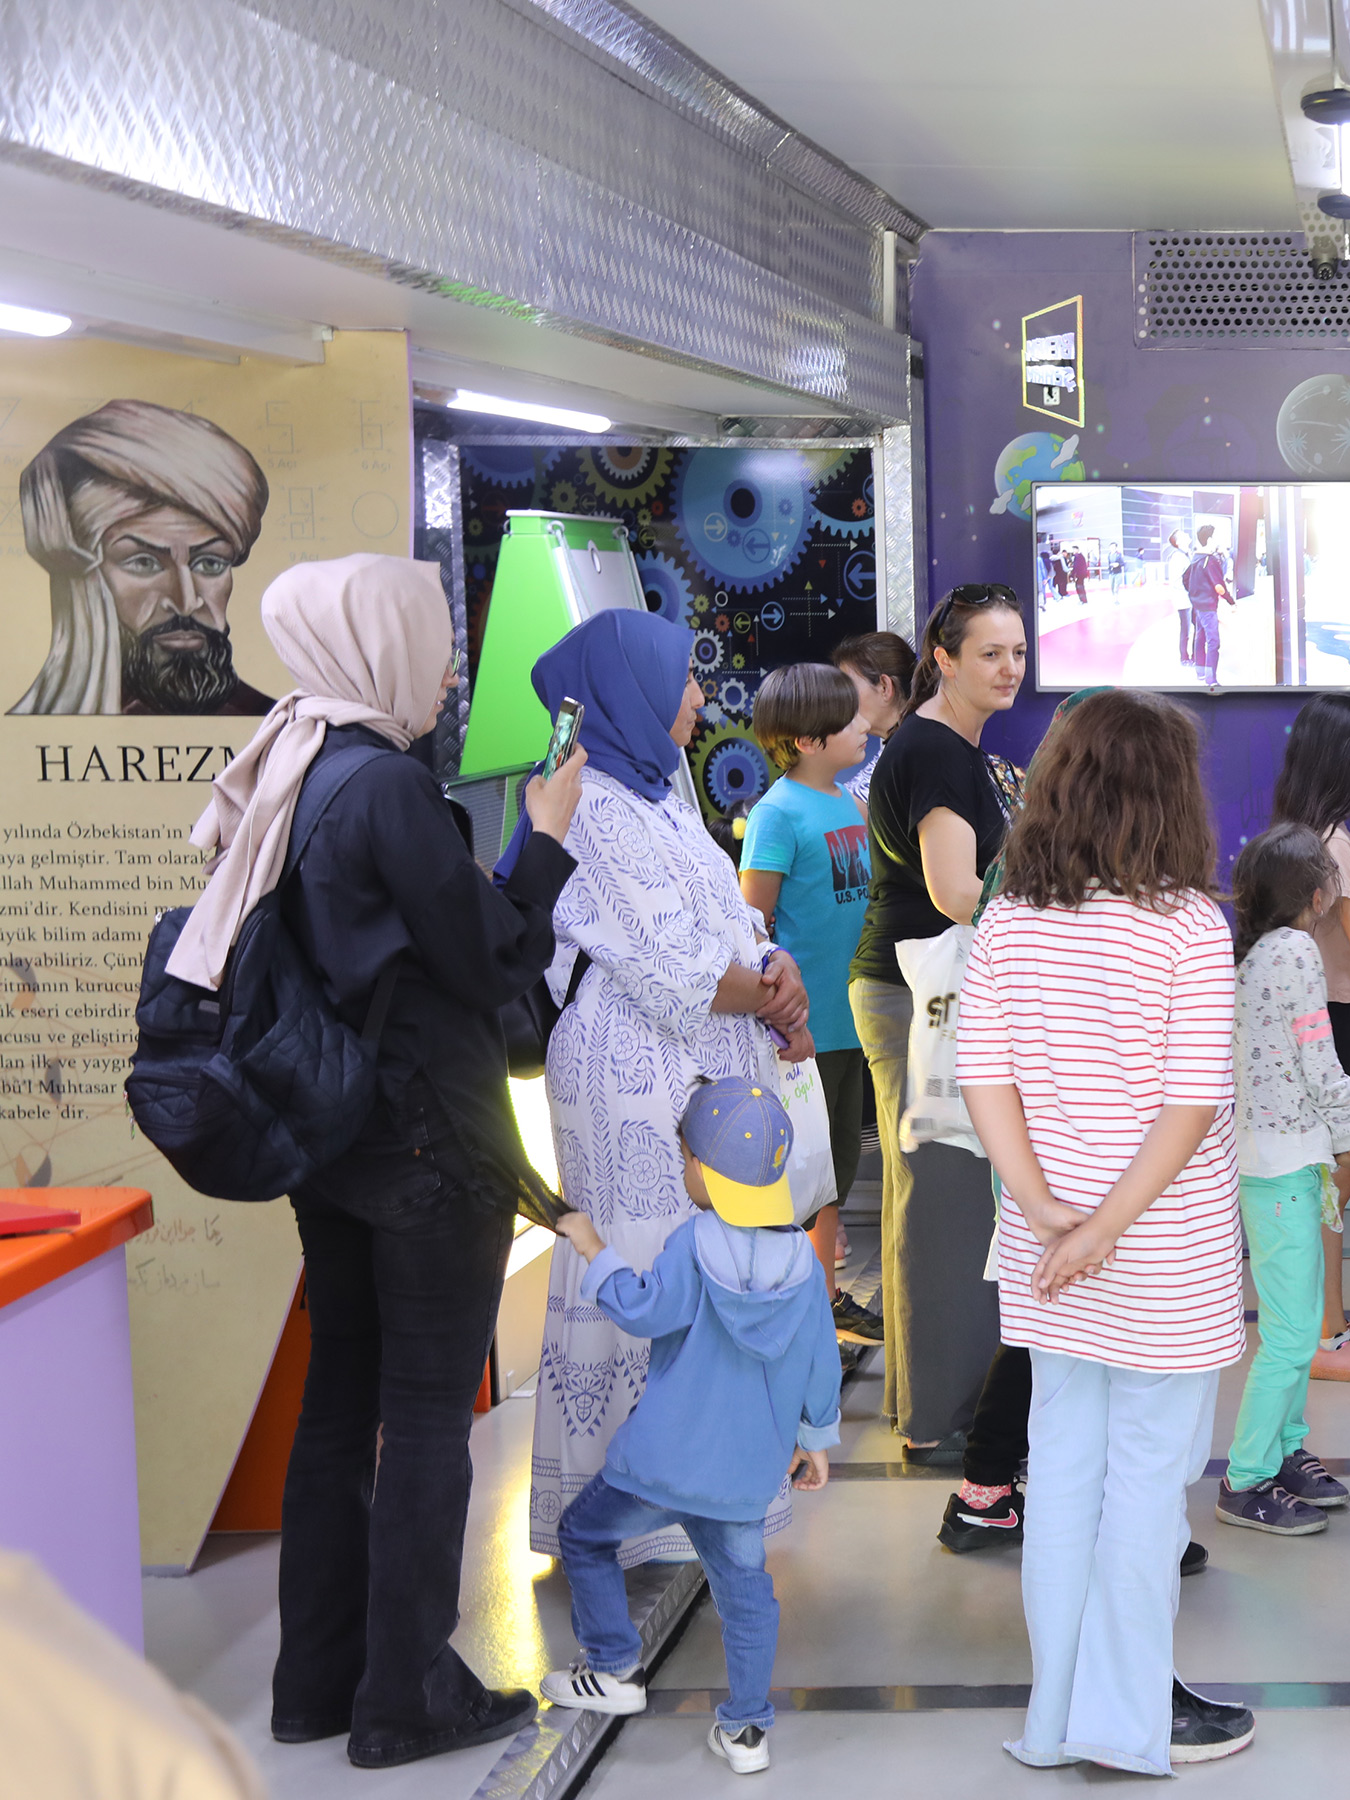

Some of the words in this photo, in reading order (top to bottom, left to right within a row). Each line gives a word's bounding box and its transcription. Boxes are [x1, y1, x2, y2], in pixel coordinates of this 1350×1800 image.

[3, 823, 62, 843] yılında
[30, 849, 110, 869] gelmiştir.
[114, 849, 152, 865] Tam
[157, 849, 209, 865] olarak
[39, 874, 141, 891] Muhammed
[146, 874, 173, 891] bin
[179, 875, 207, 891] Mu
[835, 890, 856, 904] U.S.
[69, 900, 148, 917] Kendisini
[42, 926, 87, 942] bilim
[91, 926, 142, 942] adamı
[20, 1003, 60, 1019] eseri
[64, 1002, 136, 1019] cebirdir.
[47, 1033, 66, 1044] ve
[0, 1053, 25, 1070] lan
[31, 1053, 52, 1070] ilk
[57, 1057, 77, 1069] ve
[38, 1079, 118, 1095] Muhtasar
